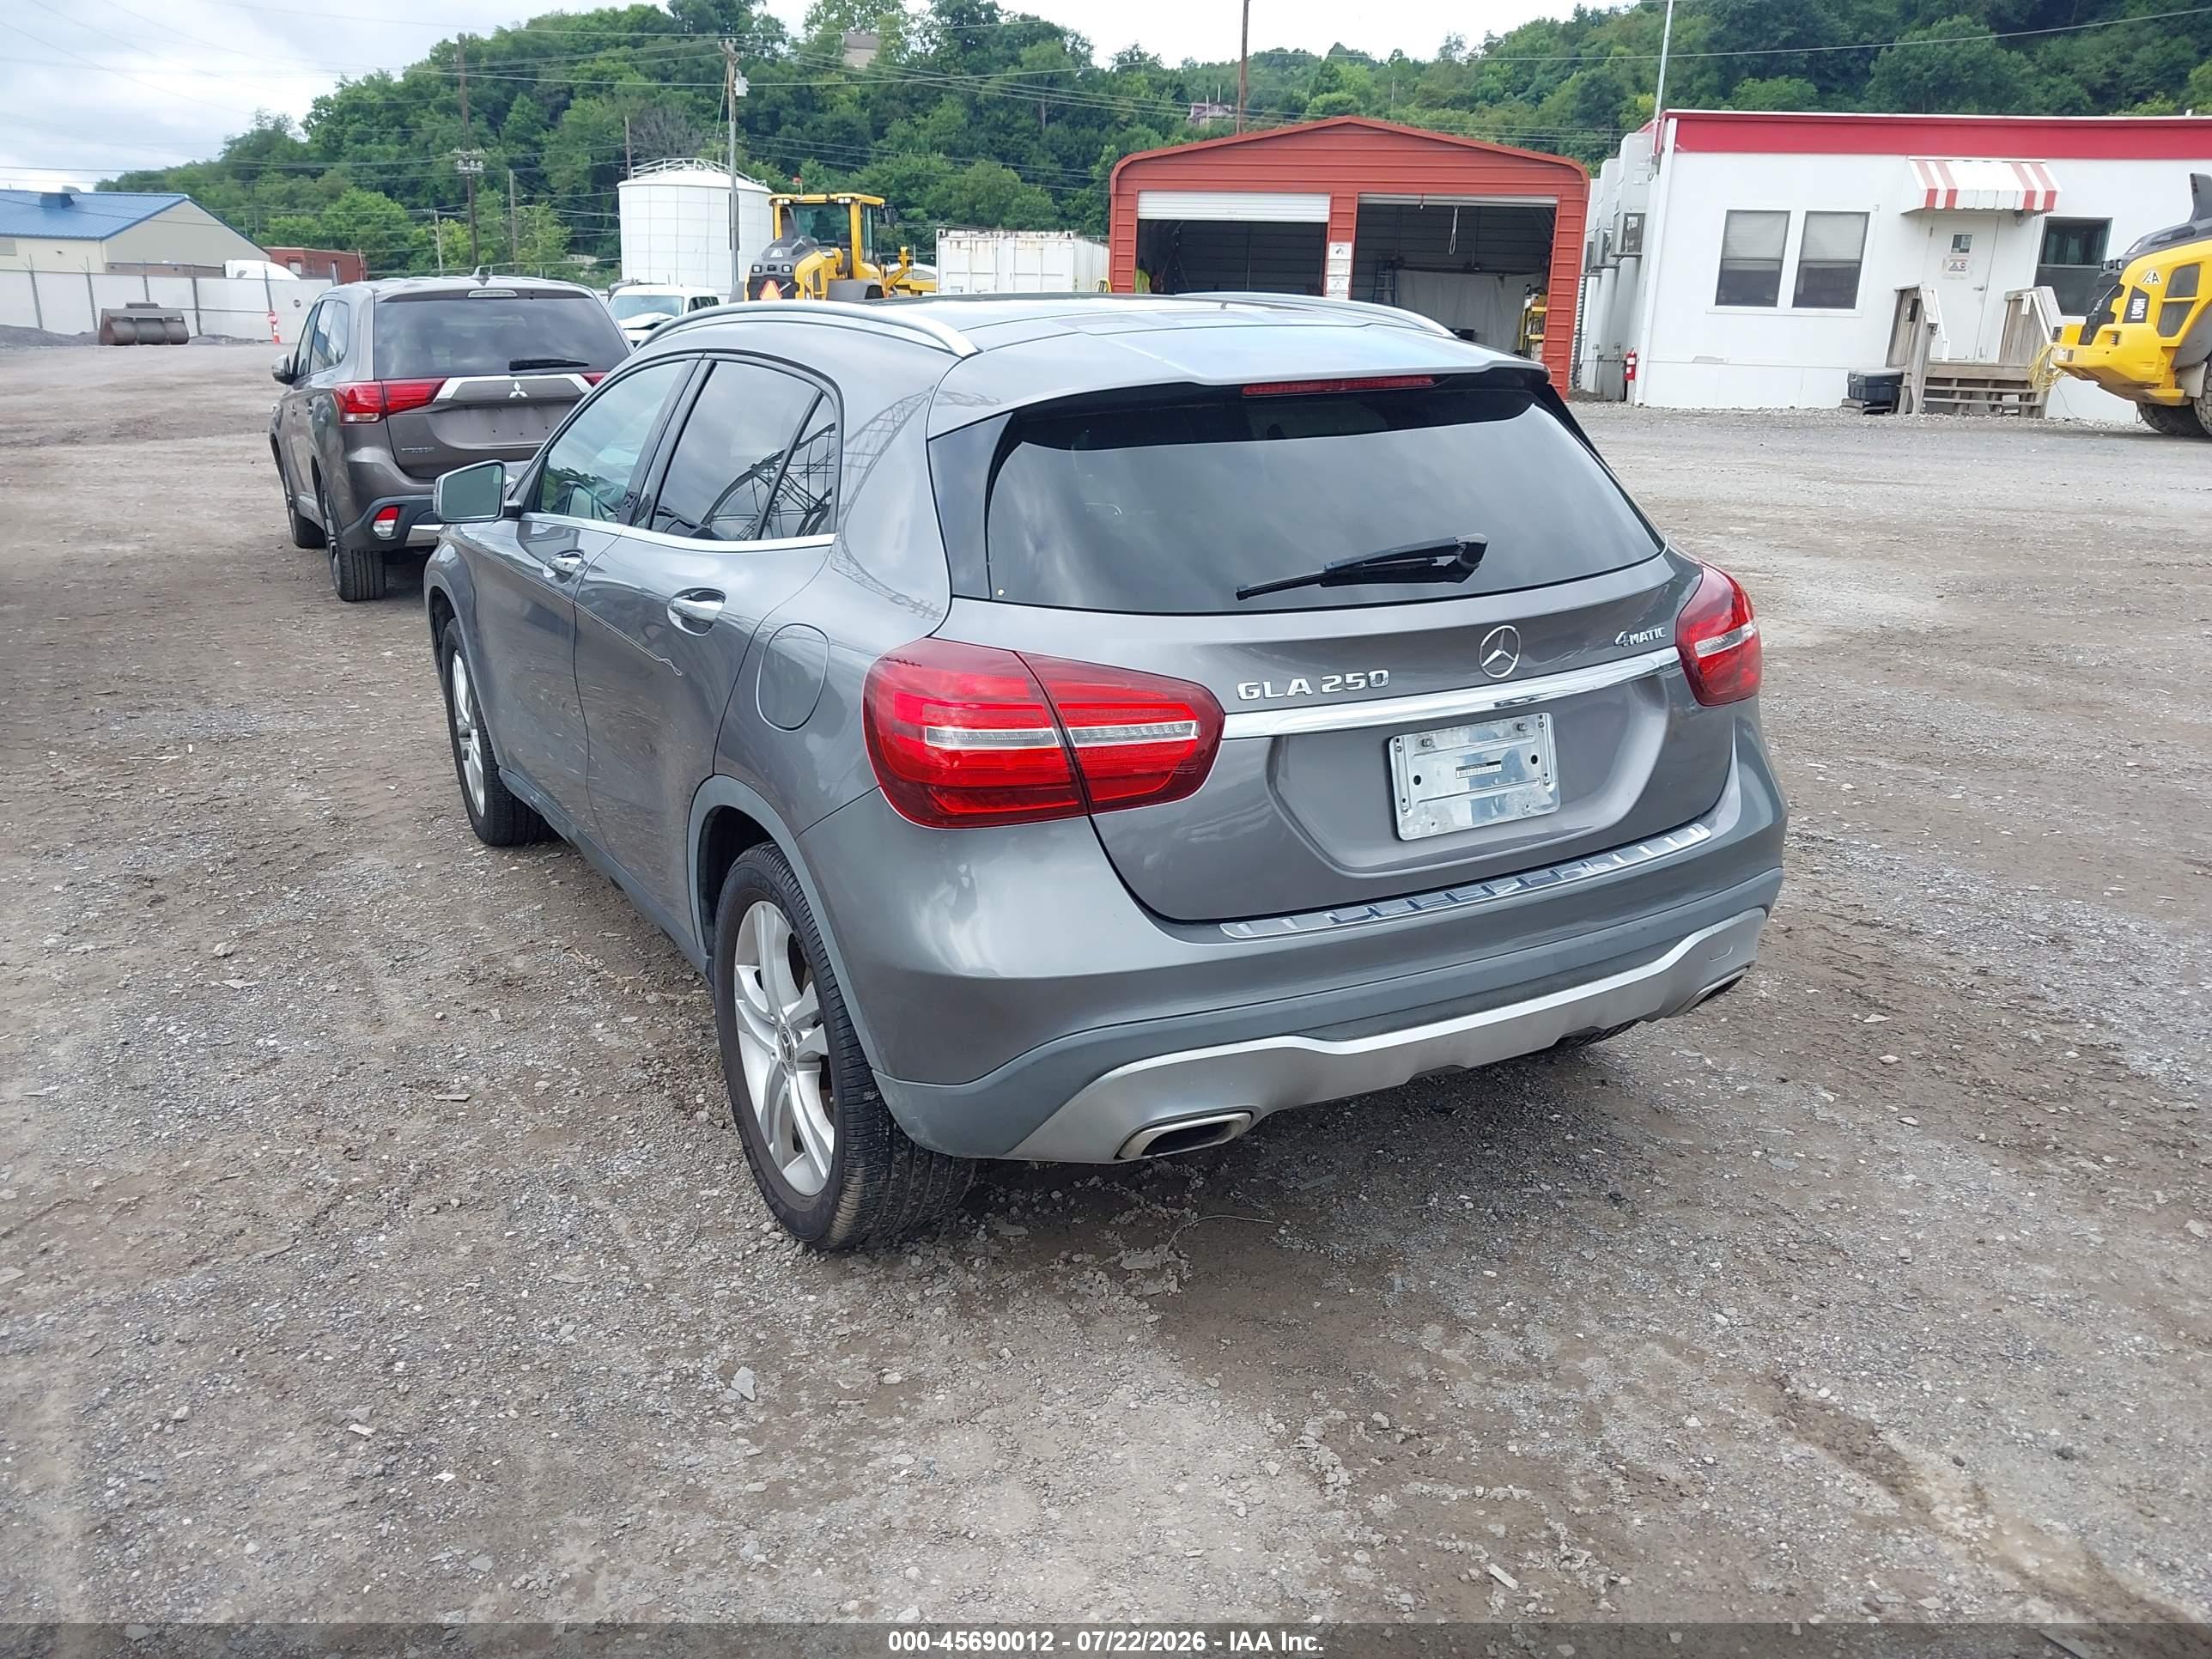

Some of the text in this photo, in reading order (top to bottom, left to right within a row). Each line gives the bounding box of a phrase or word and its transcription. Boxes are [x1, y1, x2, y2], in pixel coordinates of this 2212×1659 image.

[2130, 298, 2147, 319] L90H
[1614, 627, 1667, 647] 4MATIC
[1237, 670, 1389, 700] GLA 250
